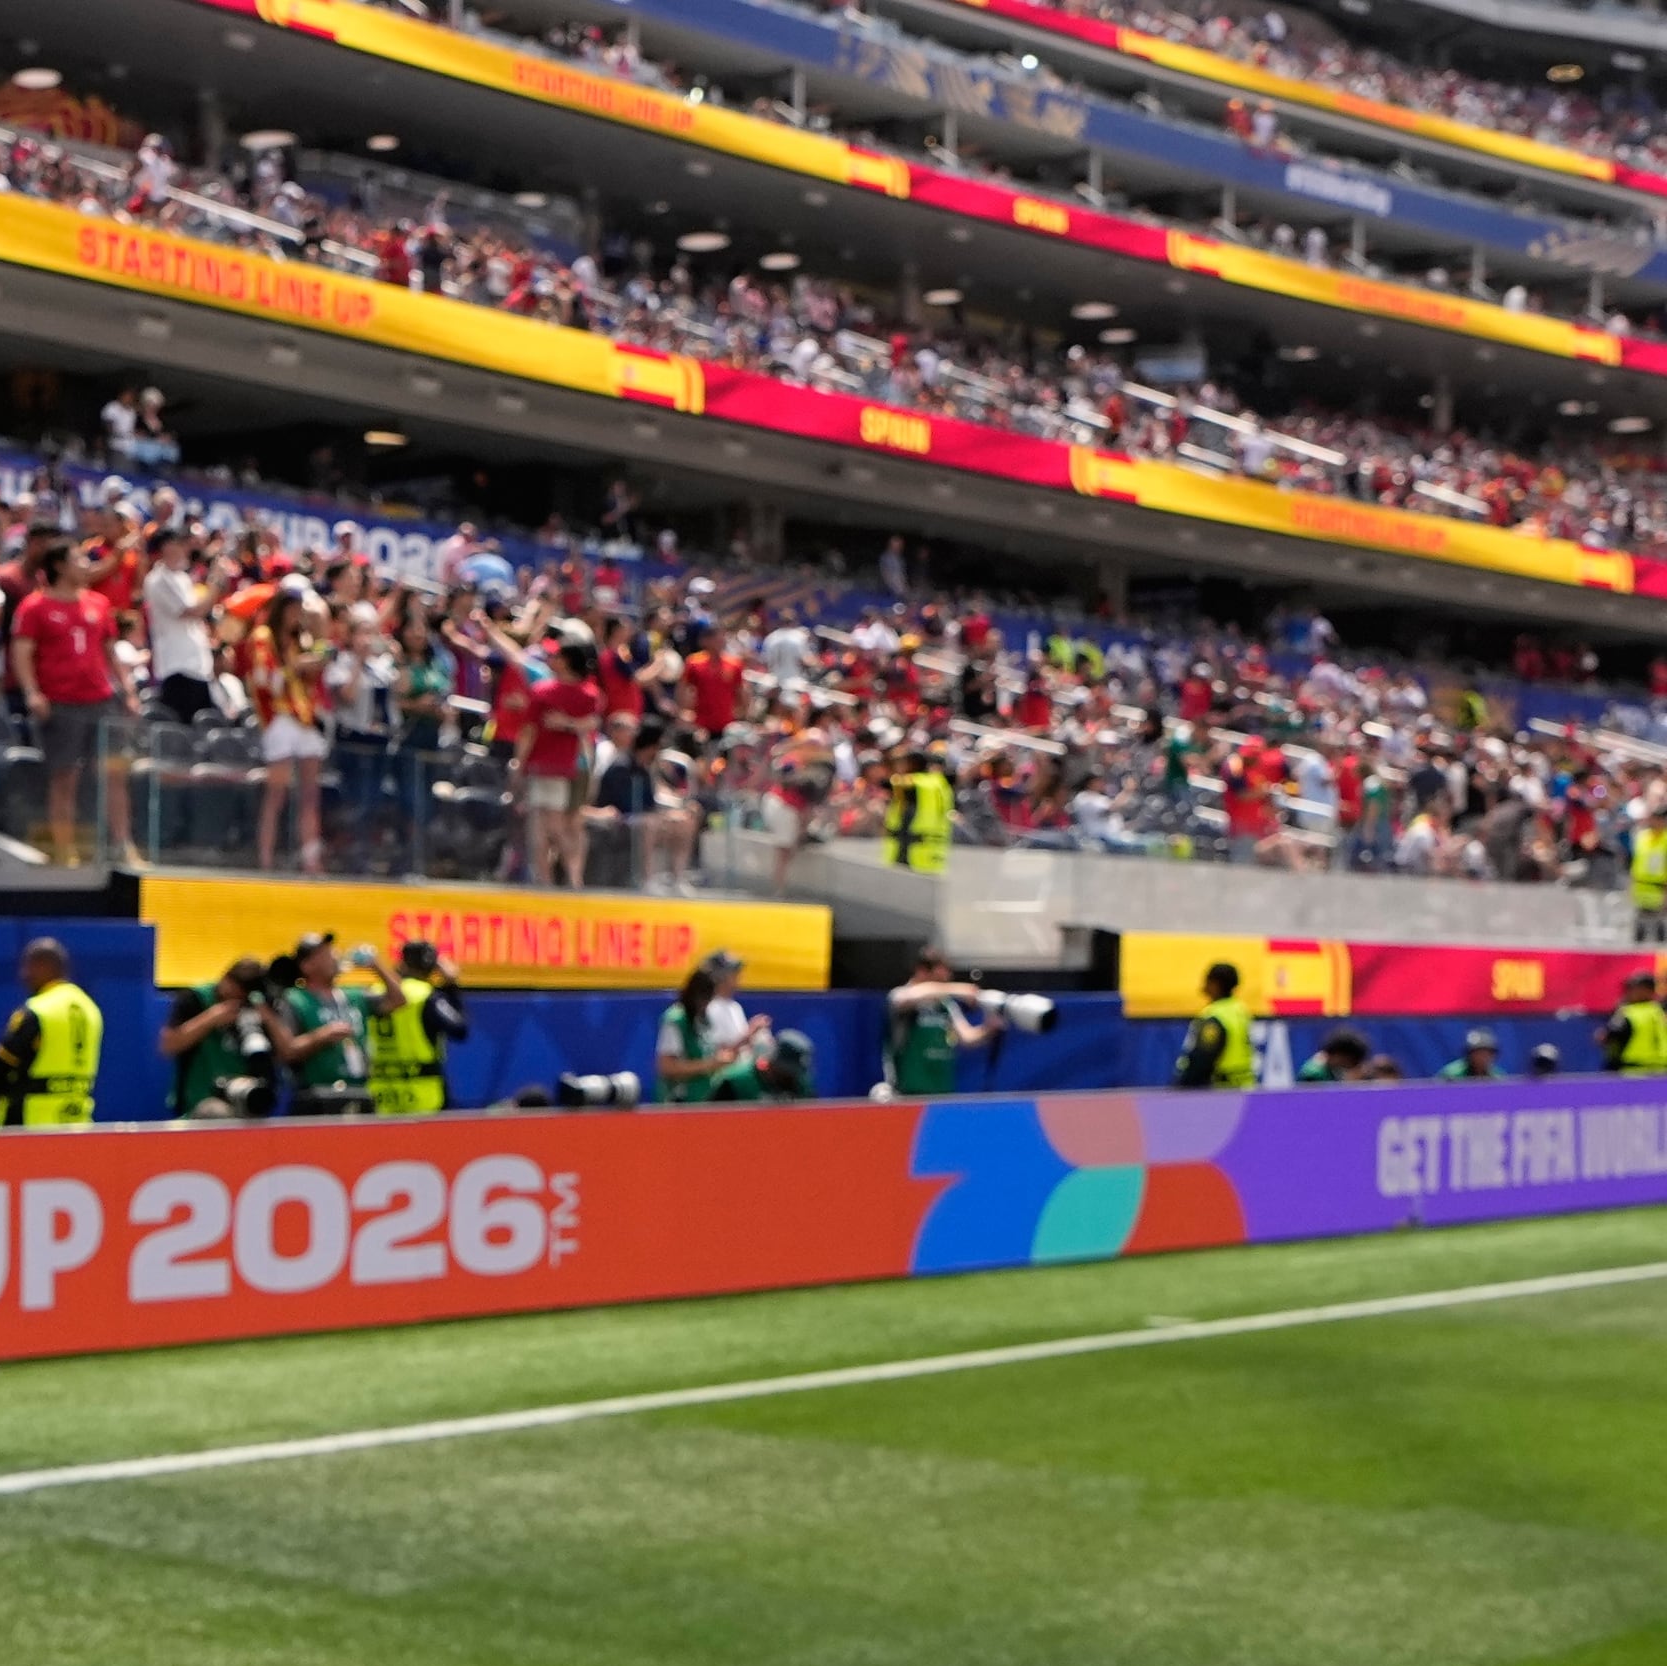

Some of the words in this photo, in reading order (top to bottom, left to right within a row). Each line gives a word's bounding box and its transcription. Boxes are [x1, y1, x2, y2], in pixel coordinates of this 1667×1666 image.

[78, 226, 244, 299] STARTING
[258, 269, 322, 319] LINE
[333, 289, 375, 325] UP
[860, 406, 931, 454] SPAIN
[388, 911, 564, 966] STARTING
[577, 918, 644, 967] LINE
[652, 922, 696, 968] UP
[1377, 1115, 1443, 1198] GET
[1448, 1112, 1507, 1193] THE
[1511, 1108, 1575, 1187] FIFA
[127, 1154, 548, 1304] 2026
[548, 1171, 579, 1269] TM
